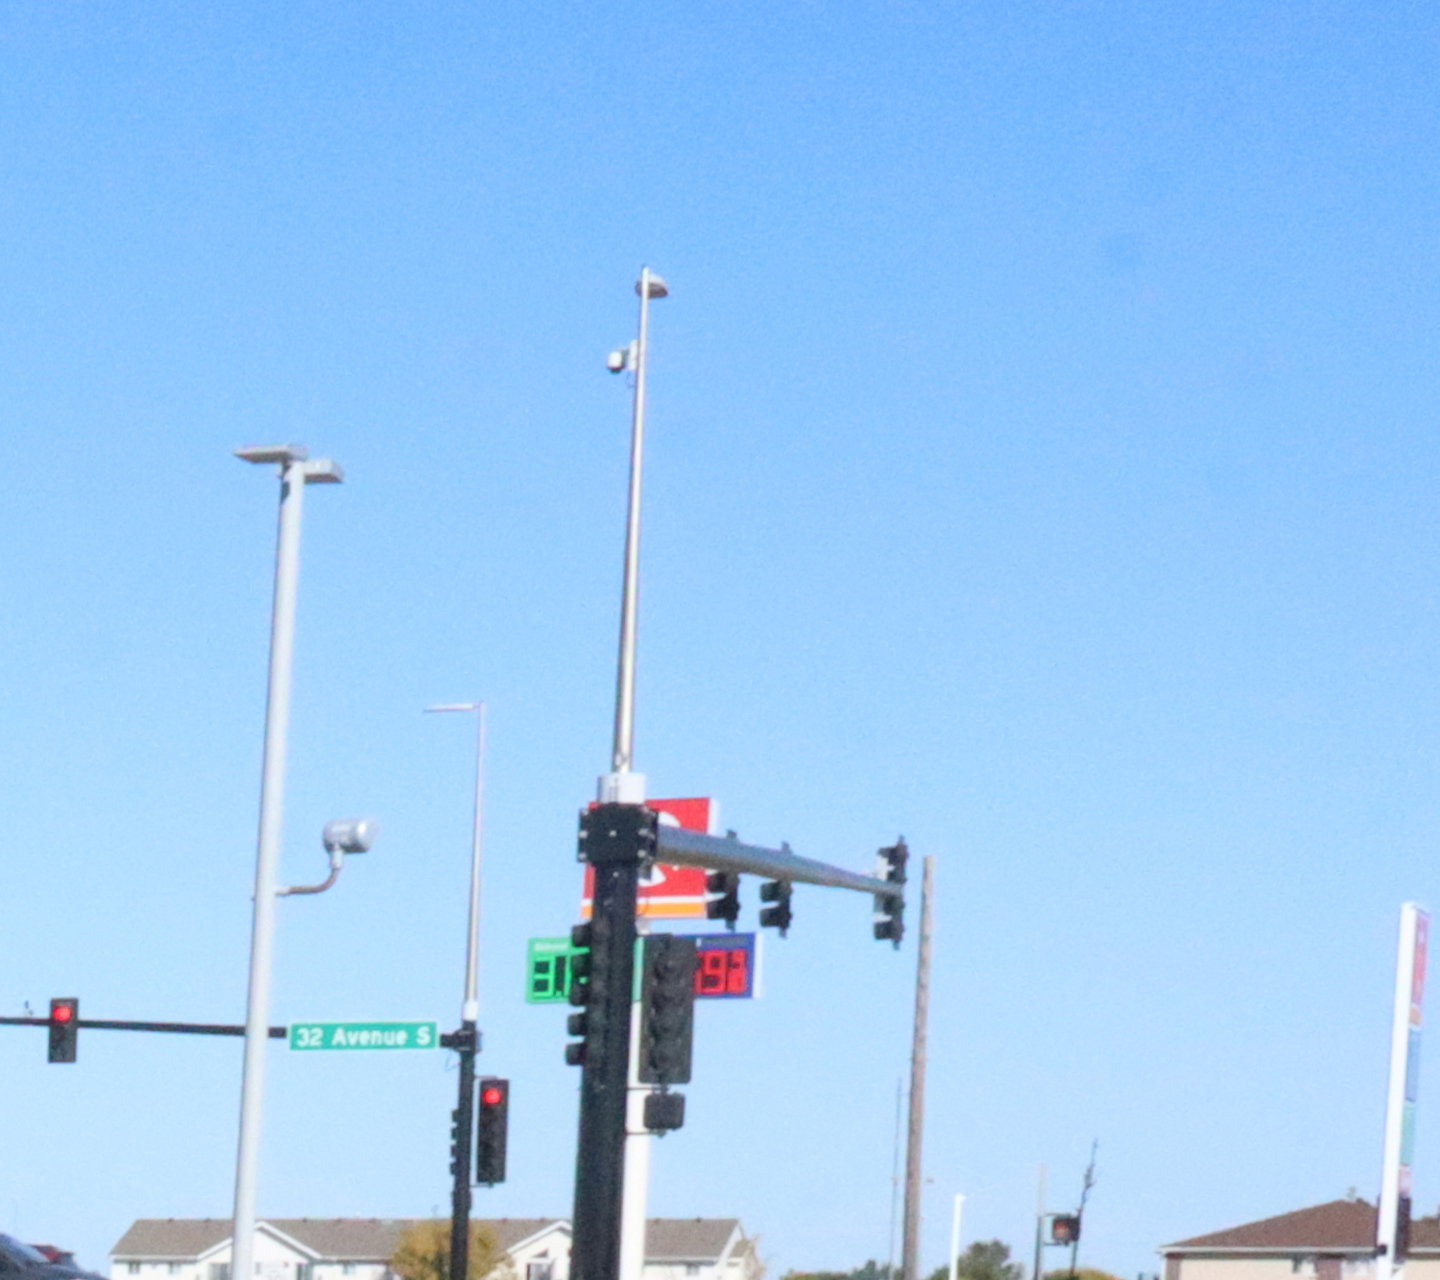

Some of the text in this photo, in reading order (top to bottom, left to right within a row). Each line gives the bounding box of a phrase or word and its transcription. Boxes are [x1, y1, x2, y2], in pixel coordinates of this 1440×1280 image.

[297, 1026, 431, 1047] 32 Avenue S
